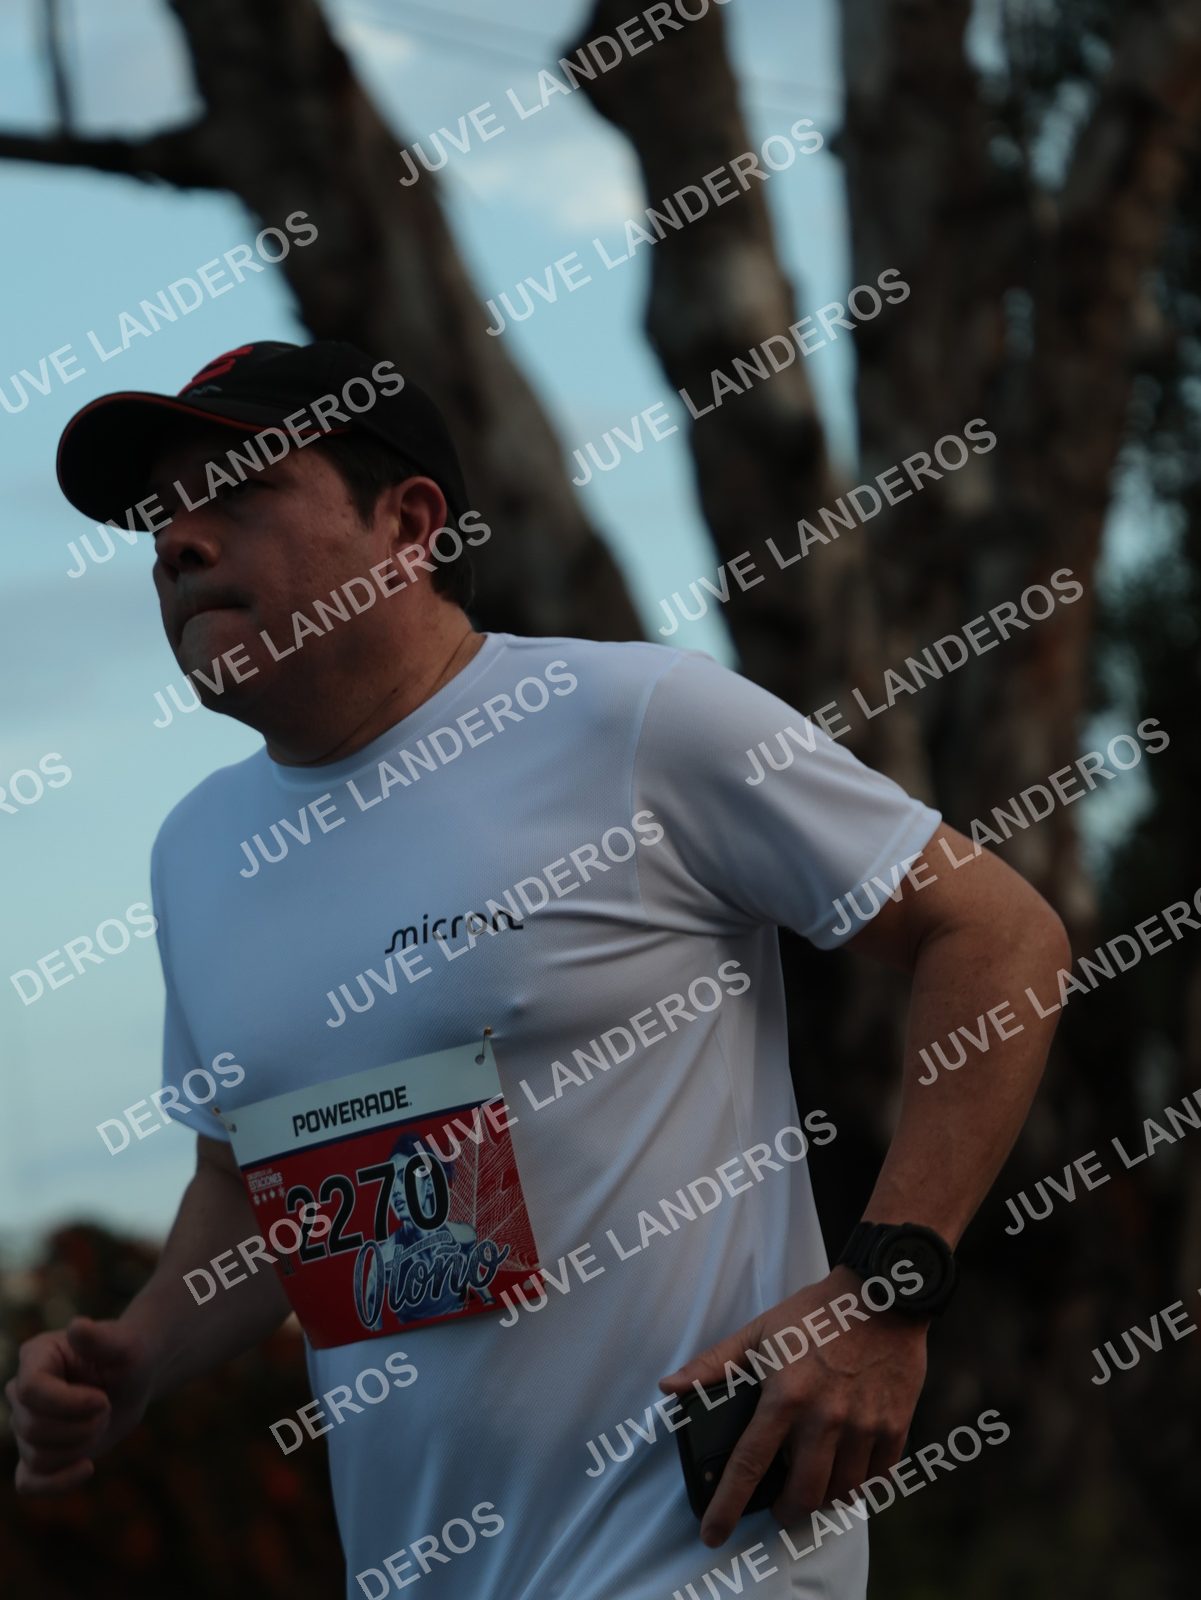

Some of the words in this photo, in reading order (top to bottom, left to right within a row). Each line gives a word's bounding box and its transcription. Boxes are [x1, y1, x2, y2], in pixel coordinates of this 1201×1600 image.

[385, 904, 524, 955] micron
[292, 1085, 409, 1137] POWERADE
[286, 1151, 450, 1264] 2270
